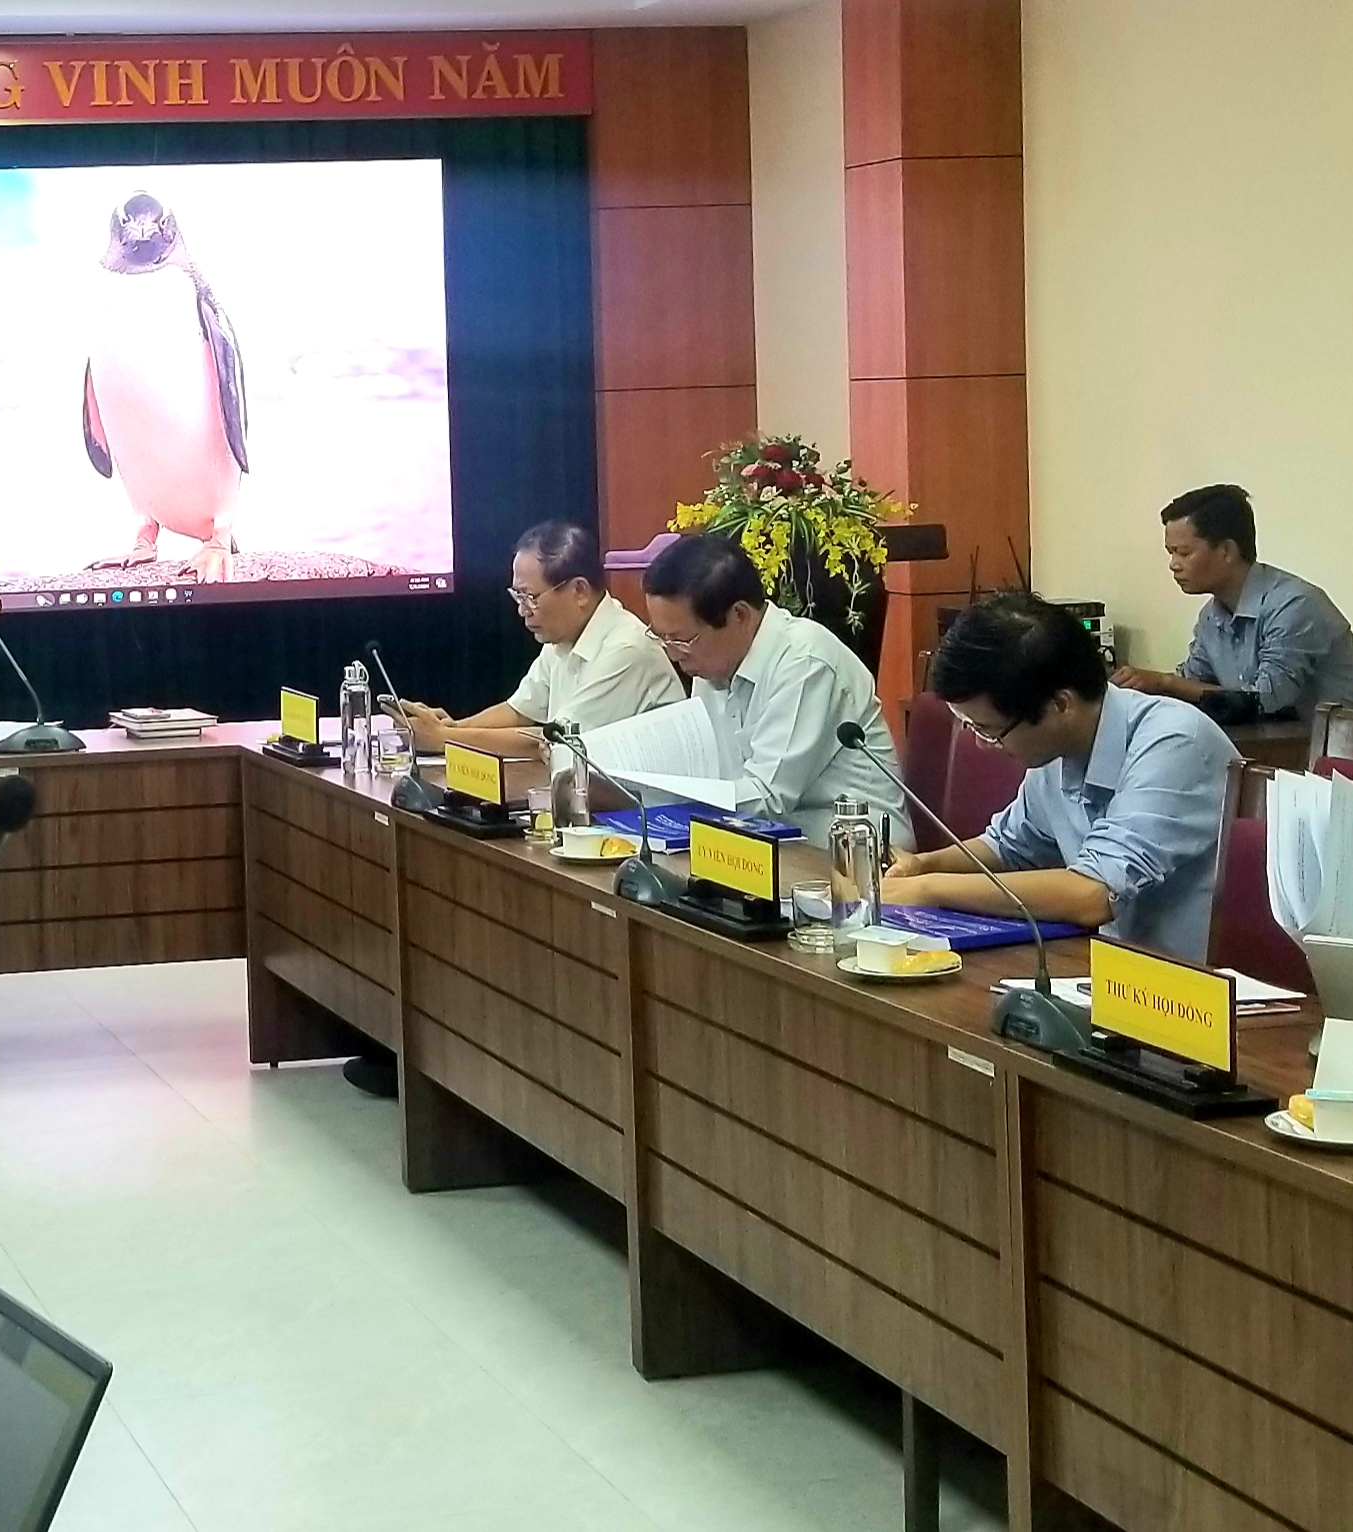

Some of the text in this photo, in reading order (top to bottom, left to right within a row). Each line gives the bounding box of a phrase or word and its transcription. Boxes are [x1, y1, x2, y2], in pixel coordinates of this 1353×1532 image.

[43, 59, 209, 107] VINH
[230, 43, 408, 103] MUÔN
[428, 41, 565, 100] NĂM
[1105, 979, 1130, 1000] THƯ
[1133, 986, 1149, 1006] KÝ
[1152, 993, 1174, 1016] HỘI
